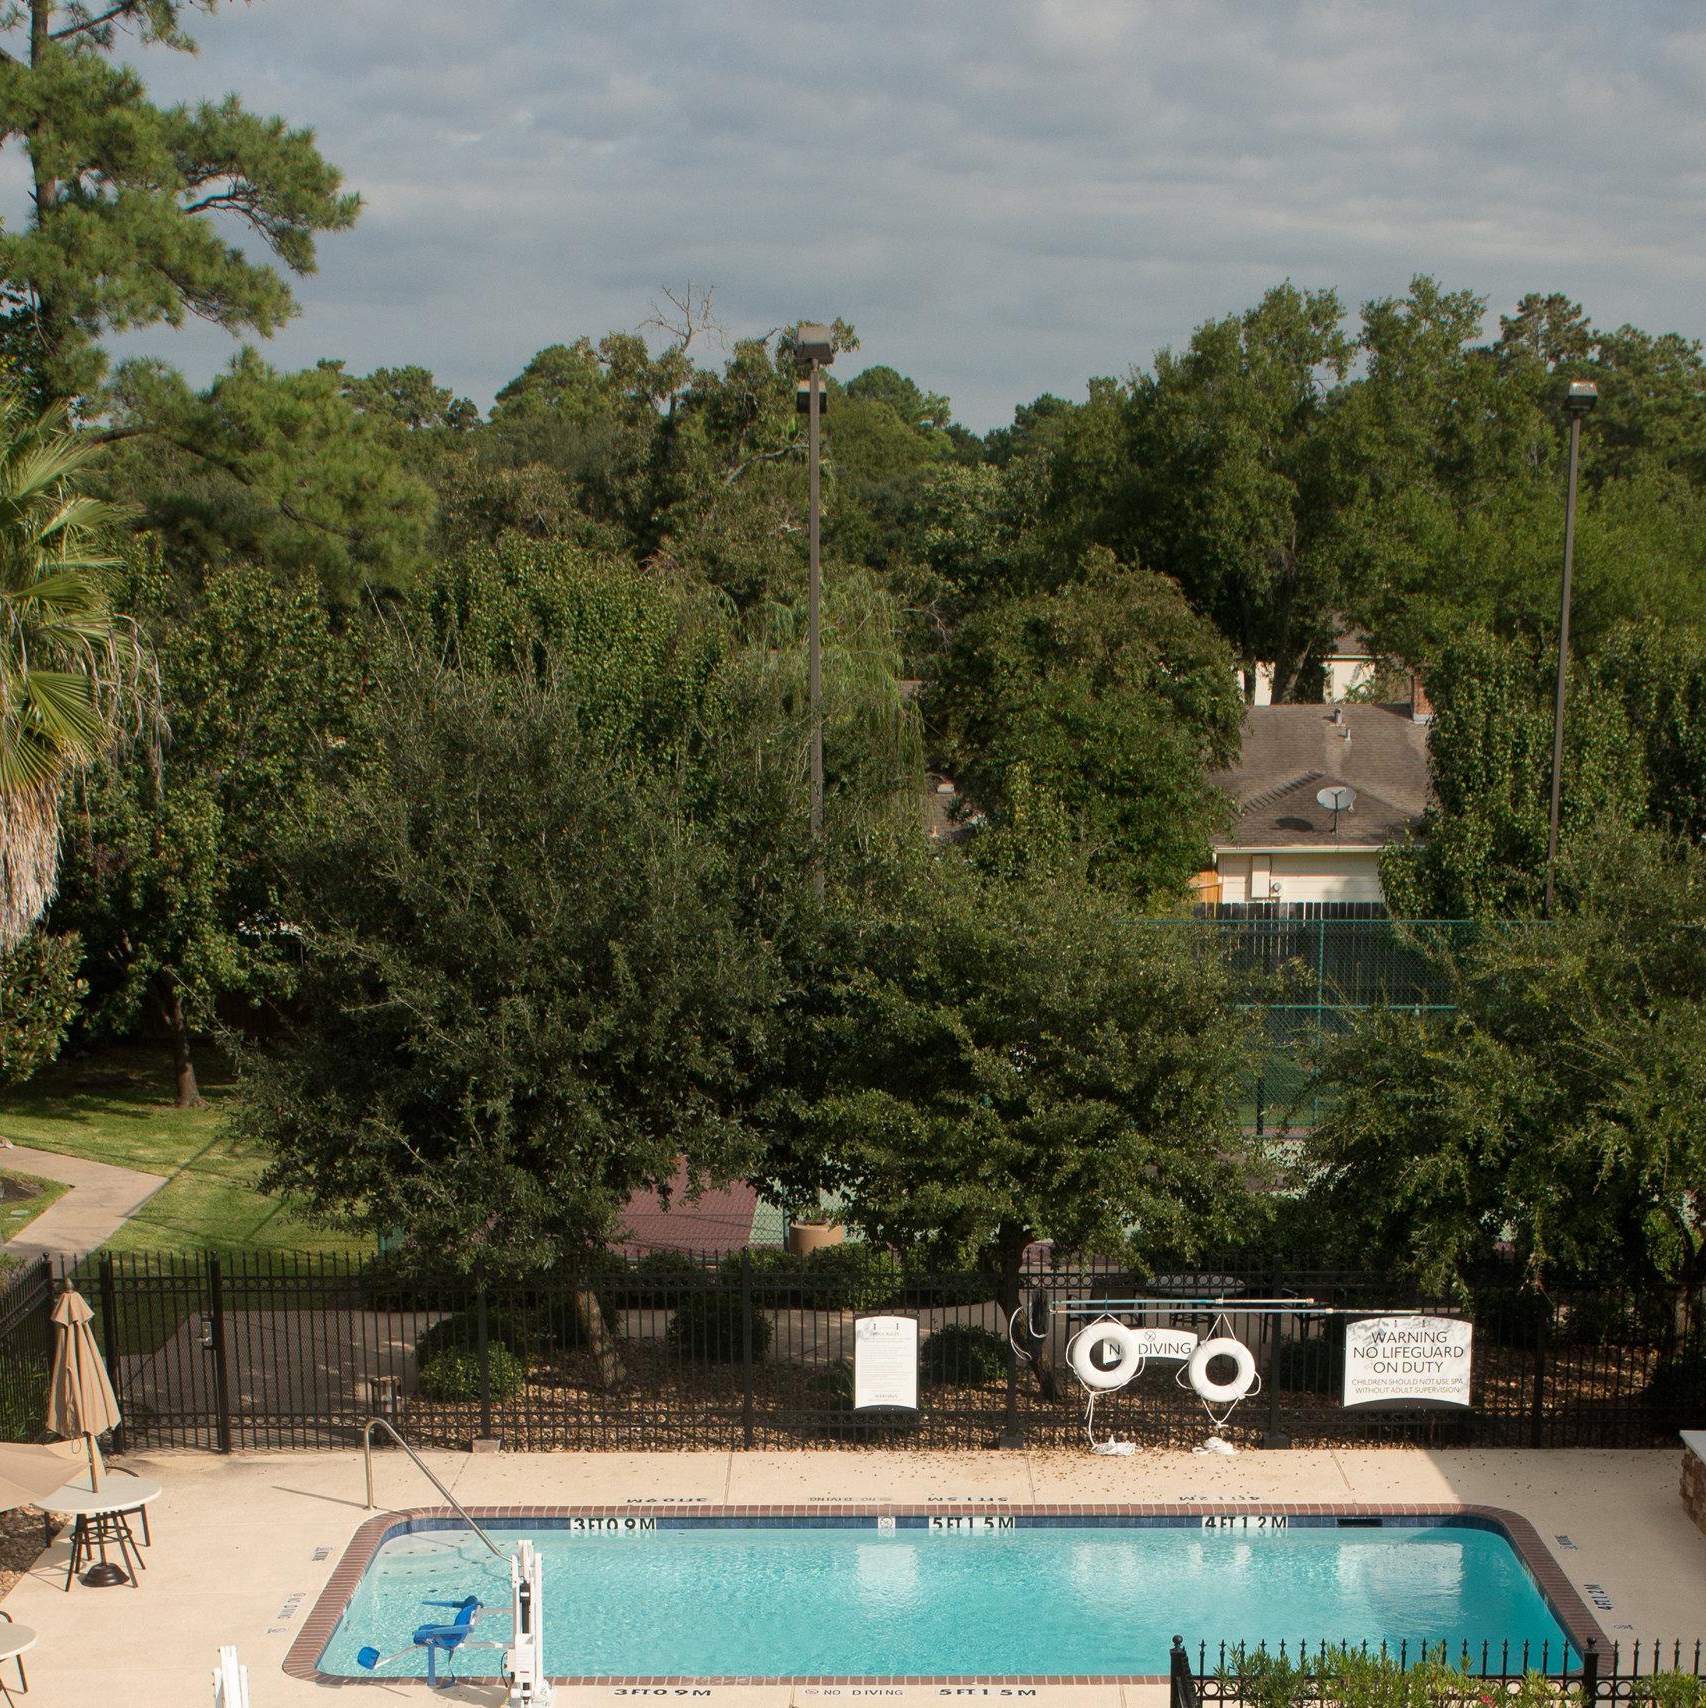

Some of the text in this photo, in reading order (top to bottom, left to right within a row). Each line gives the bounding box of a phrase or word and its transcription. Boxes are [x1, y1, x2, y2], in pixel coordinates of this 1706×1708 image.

[1371, 1331, 1447, 1343] WARNING
[1138, 1342, 1192, 1355] DIVING
[1353, 1346, 1464, 1359] NO LIFEGUARD
[1373, 1361, 1444, 1374] ON DUTY
[1351, 1378, 1464, 1386] CHILDREN SHOULD NOT USE SPA
[1355, 1386, 1461, 1394] WITHOUT ADULT SUPERVISION
